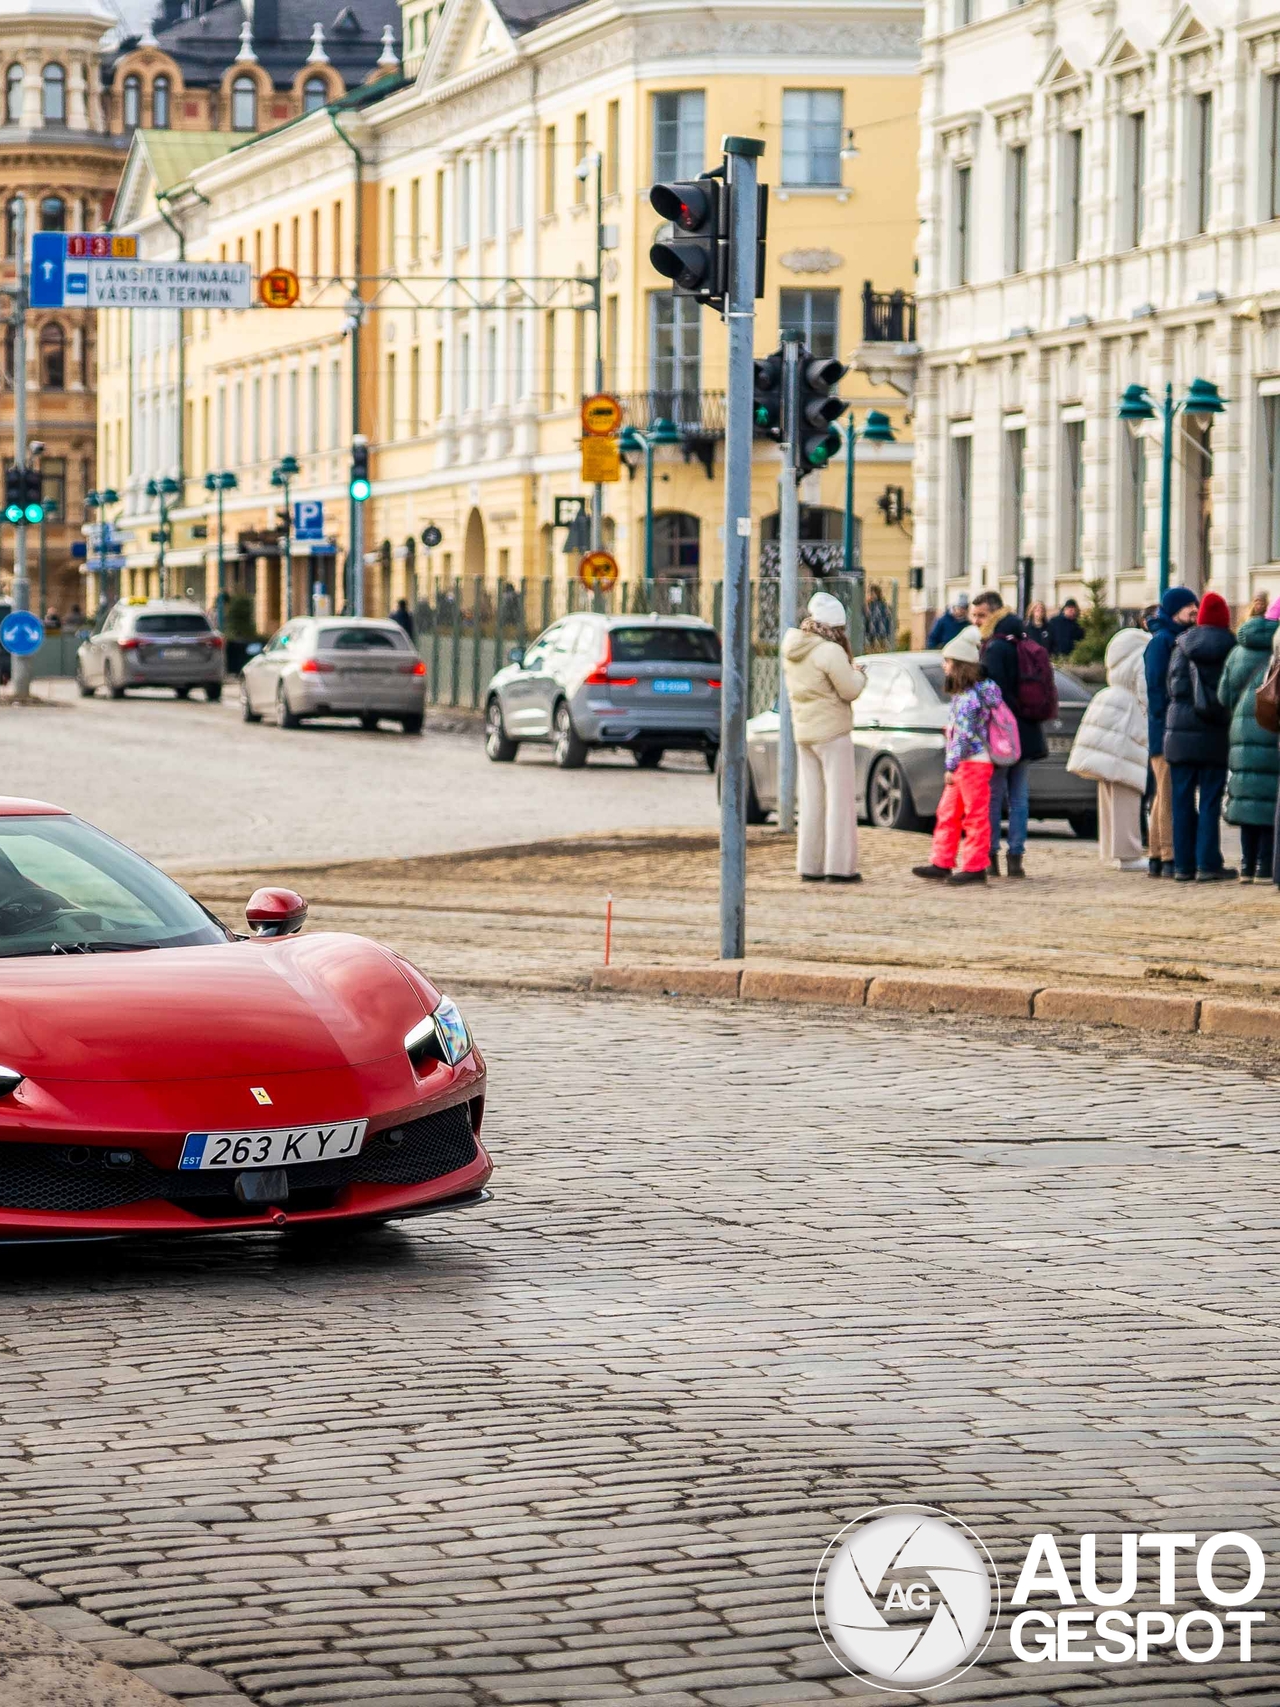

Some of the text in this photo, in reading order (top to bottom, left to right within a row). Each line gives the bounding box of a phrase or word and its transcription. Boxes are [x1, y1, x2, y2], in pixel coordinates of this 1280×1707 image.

[75, 237, 83, 256] 1
[299, 503, 319, 529] P
[183, 1156, 202, 1166] EST
[209, 1135, 273, 1165] 263
